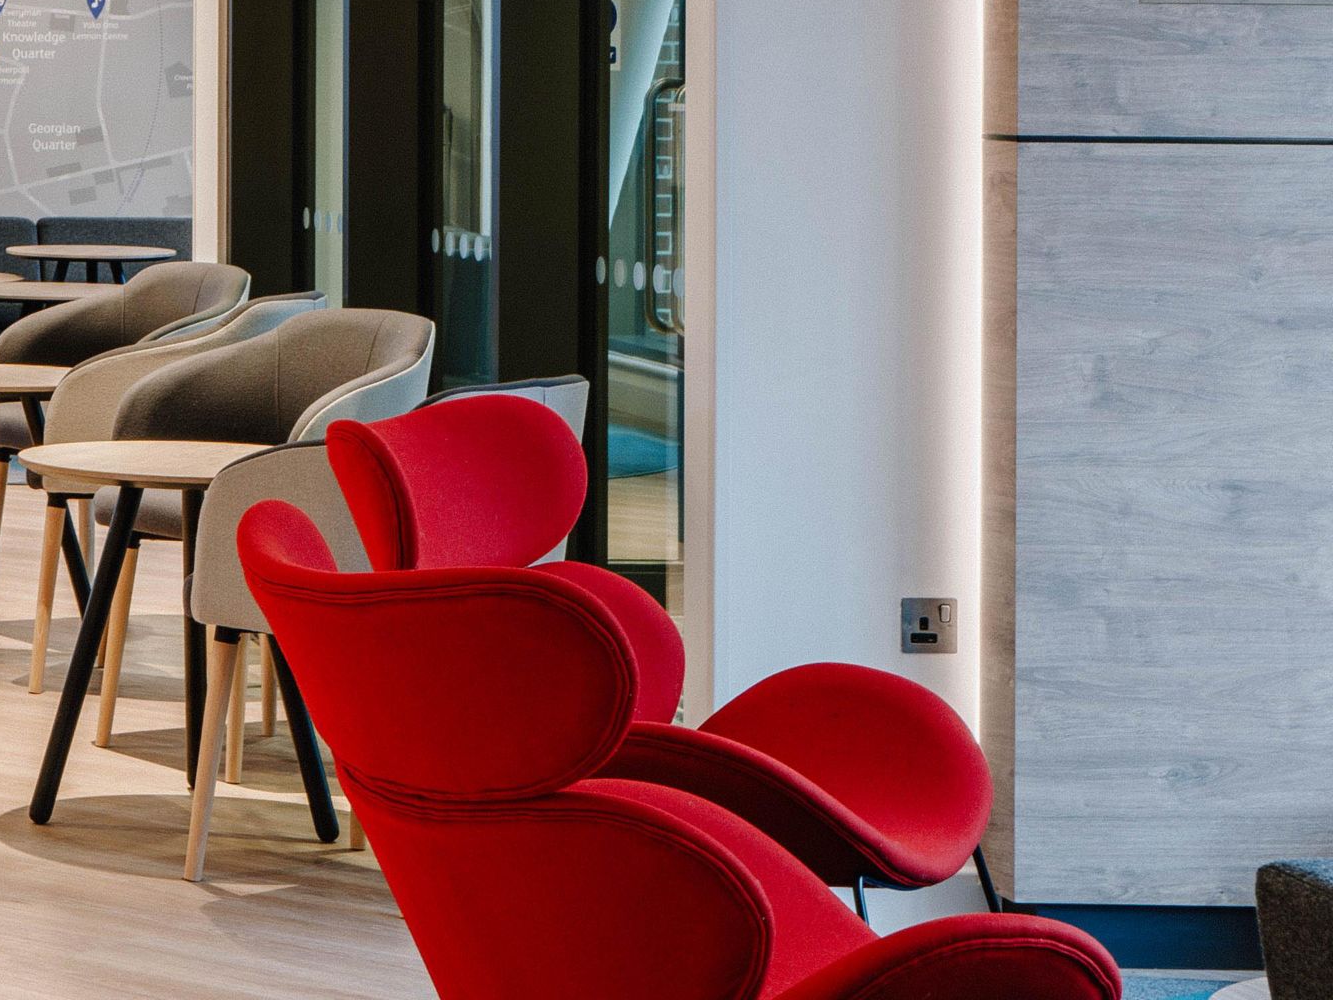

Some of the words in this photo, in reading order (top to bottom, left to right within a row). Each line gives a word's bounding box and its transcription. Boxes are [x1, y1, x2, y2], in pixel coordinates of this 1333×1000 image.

[7, 20, 37, 28] Theatre
[83, 21, 101, 29] Yoko
[103, 21, 119, 29] Ono
[2, 32, 66, 44] Knowledge
[102, 32, 128, 40] Centre
[12, 49, 56, 61] Quarter
[28, 122, 81, 135] Georgian
[33, 140, 77, 151] Quarter
